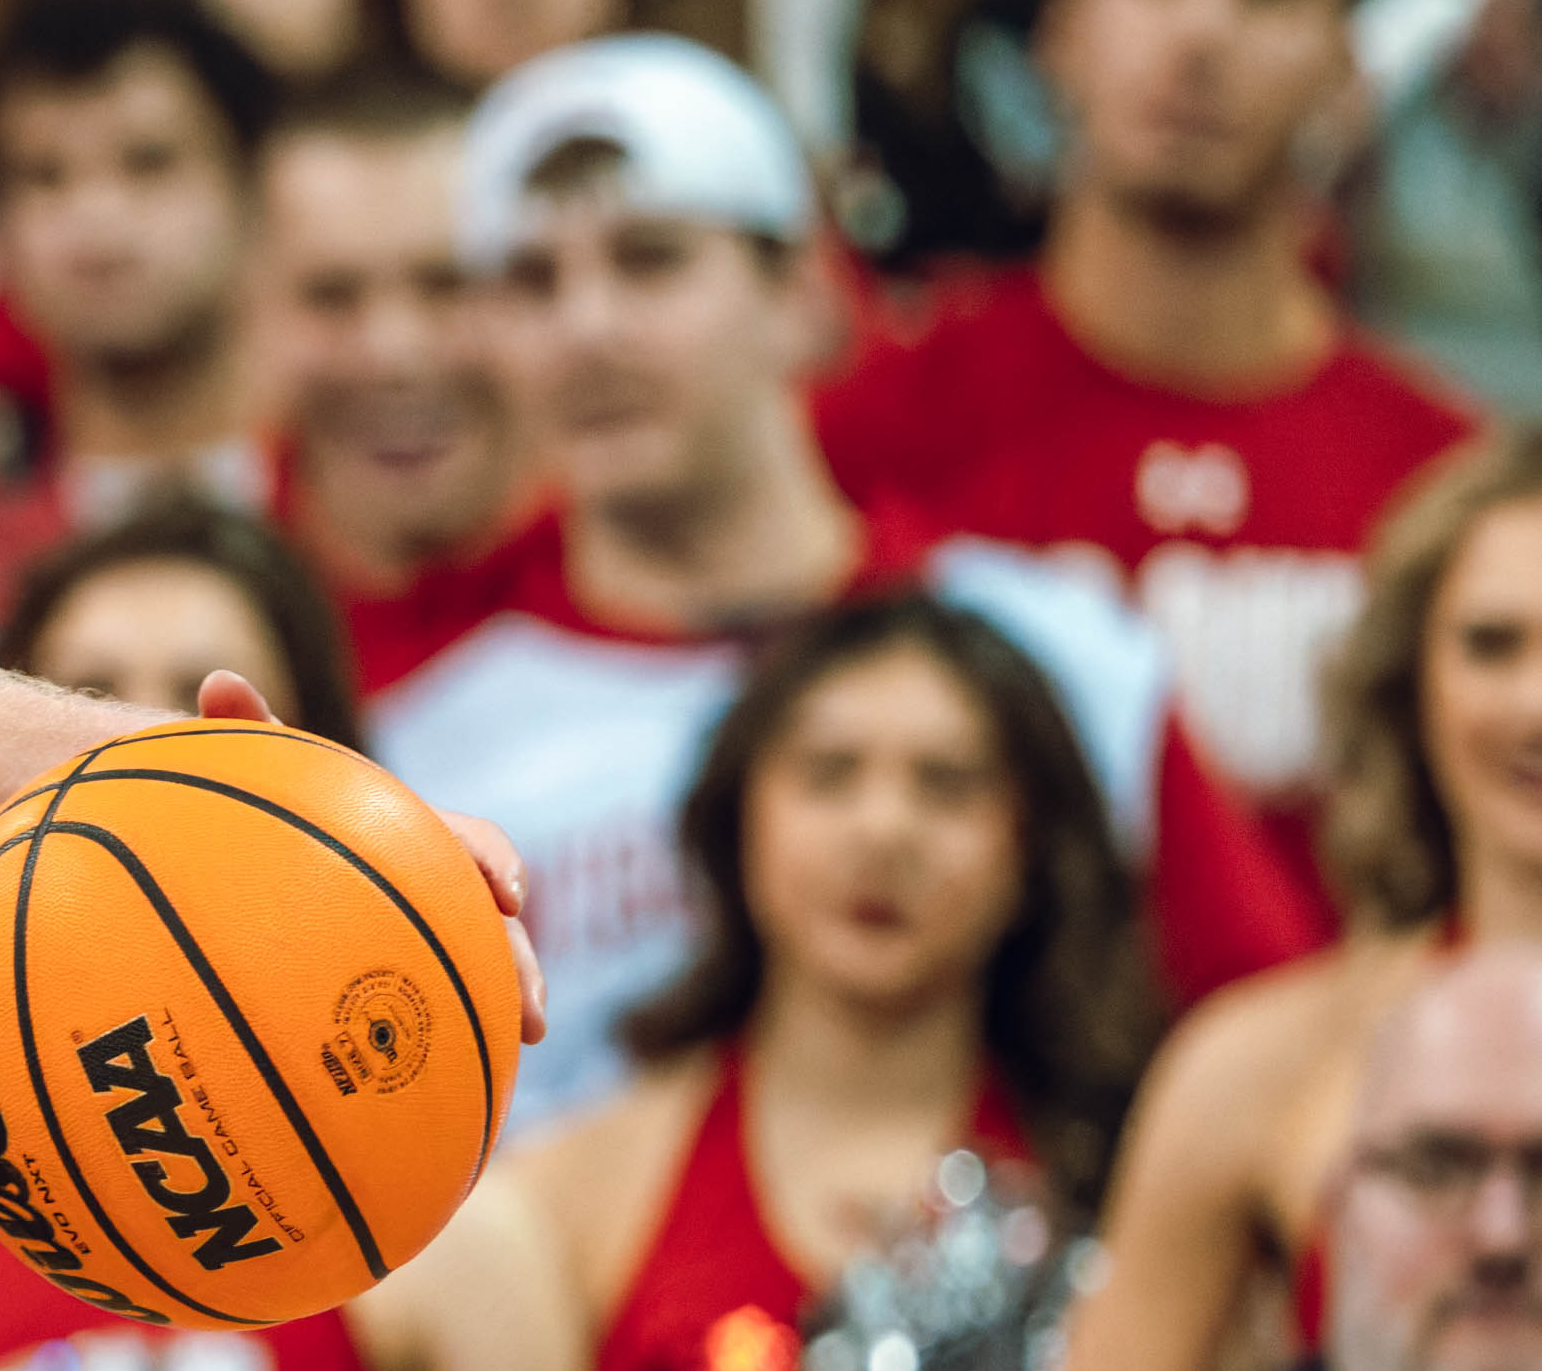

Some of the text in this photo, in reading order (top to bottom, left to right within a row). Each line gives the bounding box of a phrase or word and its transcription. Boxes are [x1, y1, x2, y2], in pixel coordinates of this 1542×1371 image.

[76, 1013, 285, 1272] NCAA
[160, 1006, 306, 1245] OFFICIAL GAME BALL
